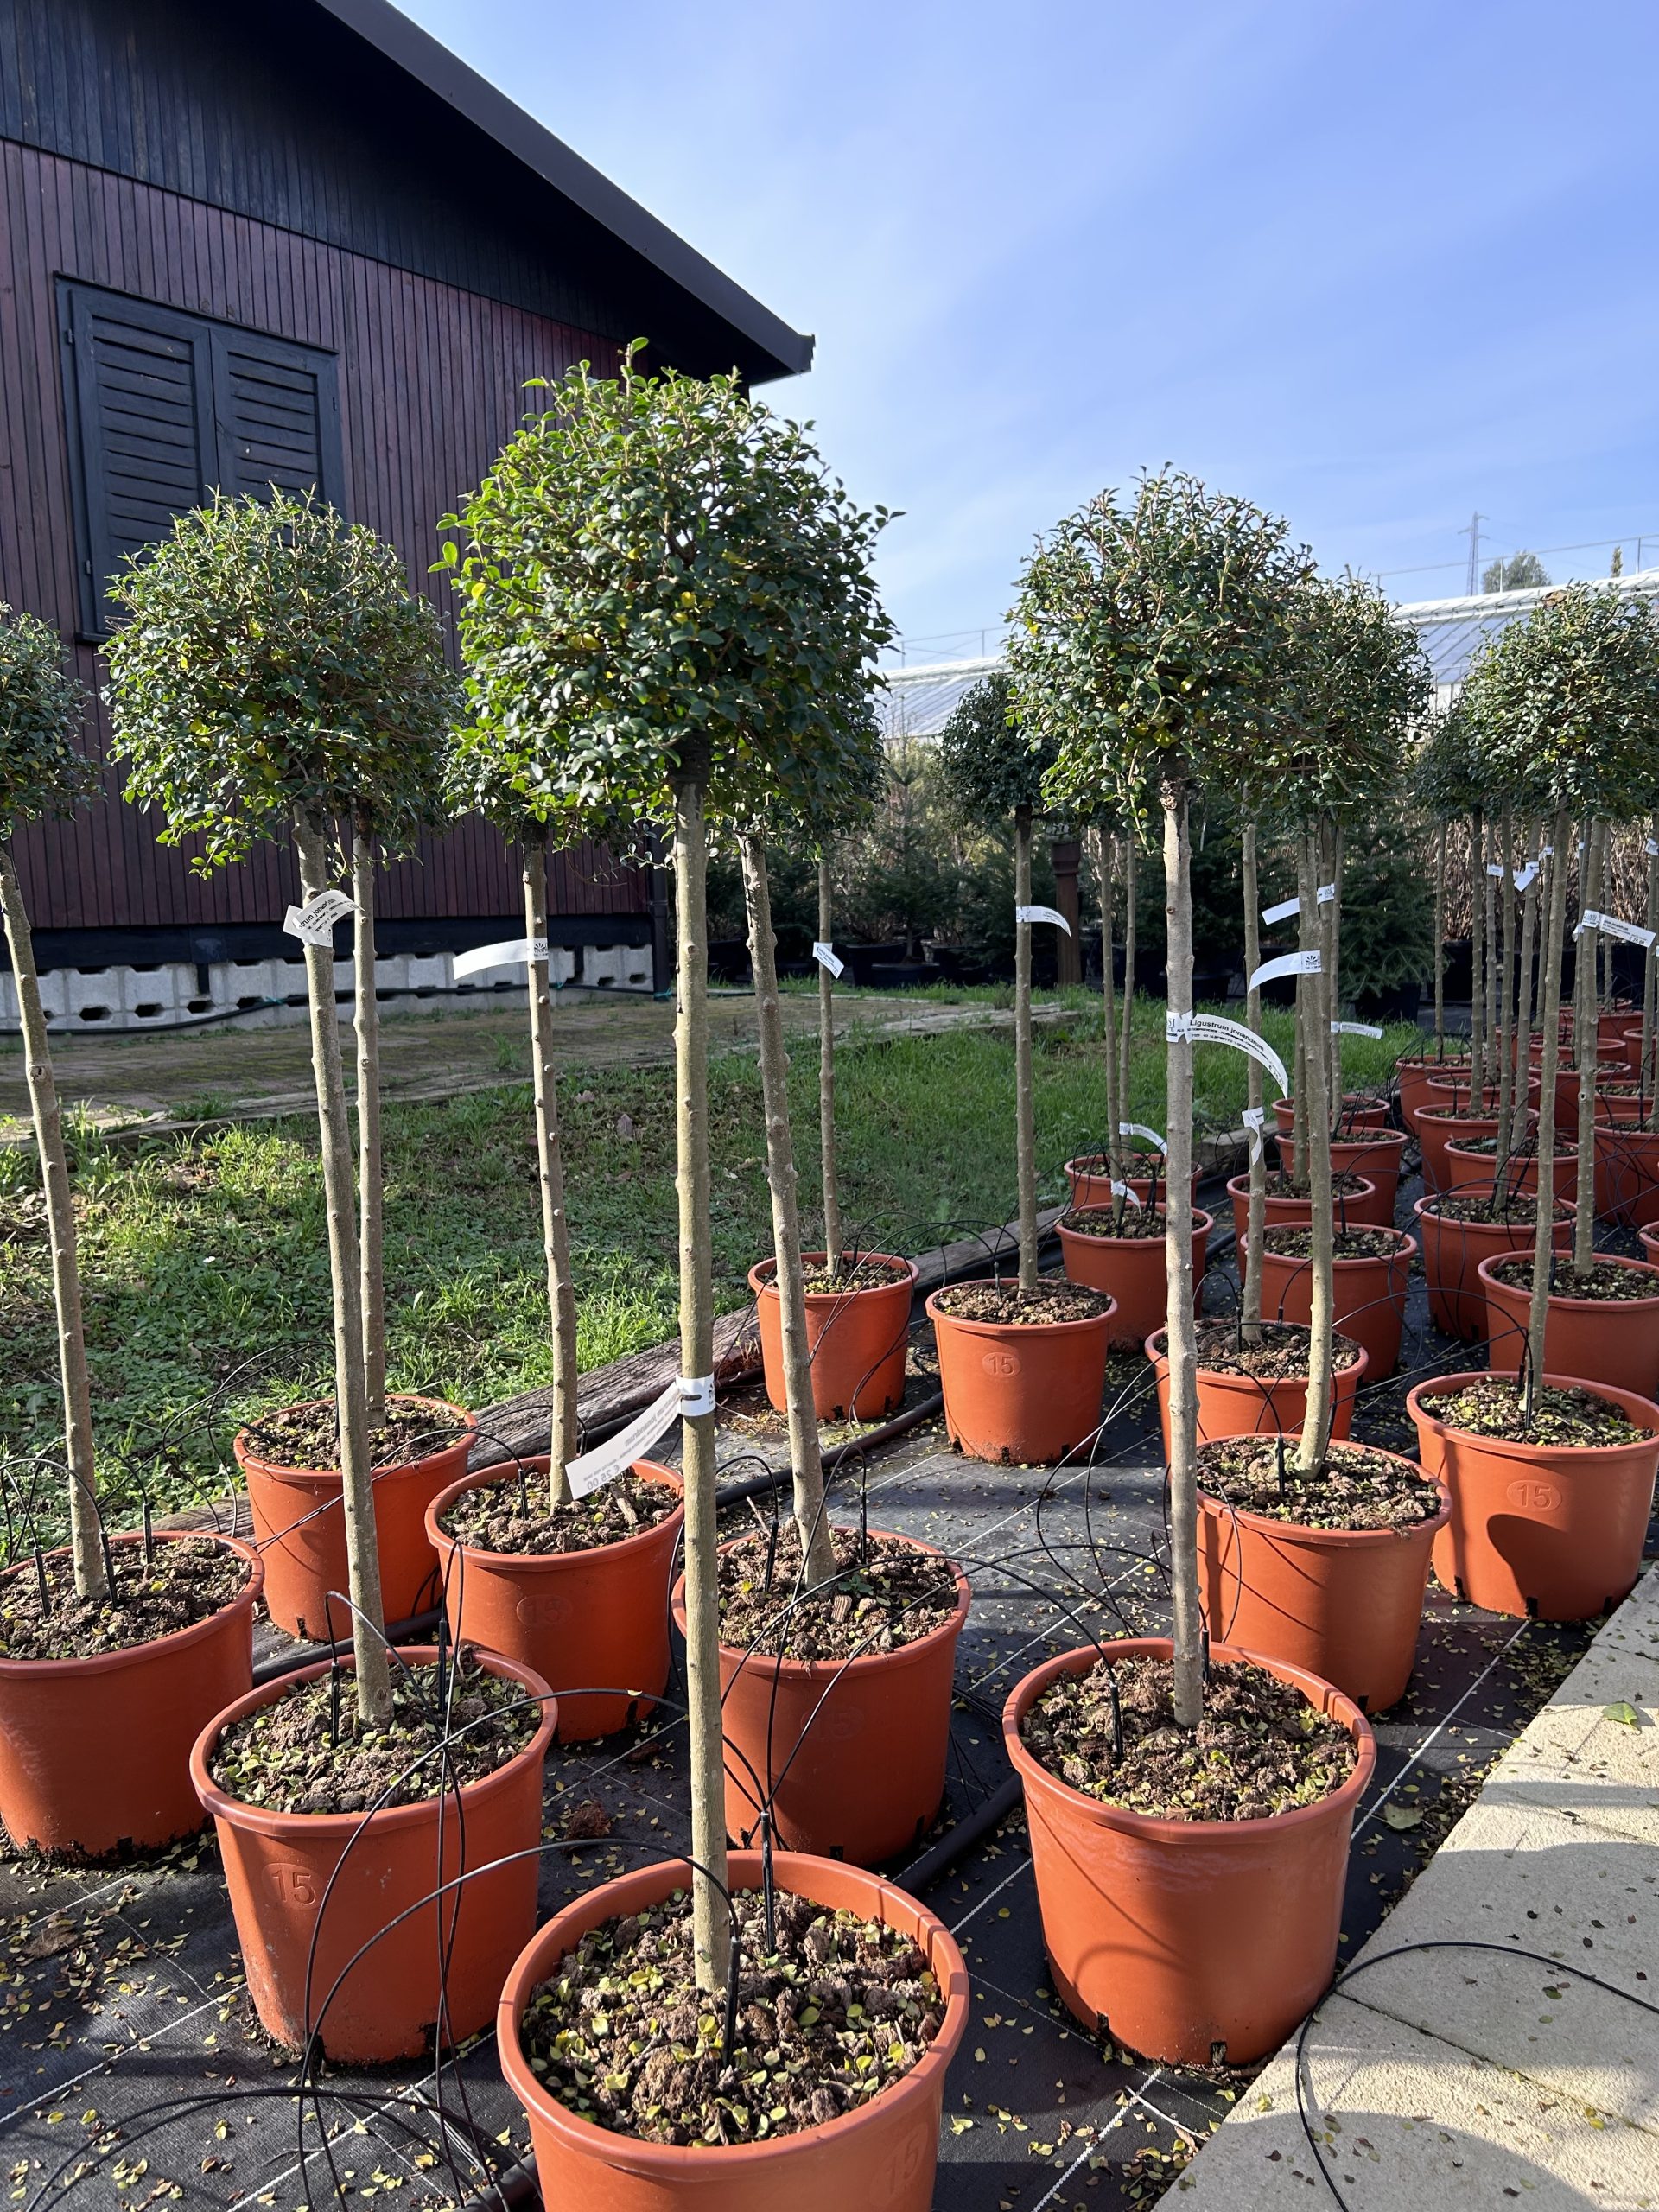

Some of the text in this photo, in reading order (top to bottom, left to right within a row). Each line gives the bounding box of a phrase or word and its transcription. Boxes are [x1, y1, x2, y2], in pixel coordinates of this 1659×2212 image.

[1190, 1020, 1230, 1031] Ligustrum
[989, 1355, 1015, 1376] 15
[1517, 1484, 1552, 1510] 15
[525, 1598, 562, 1623] 15
[272, 1869, 316, 1906] 15
